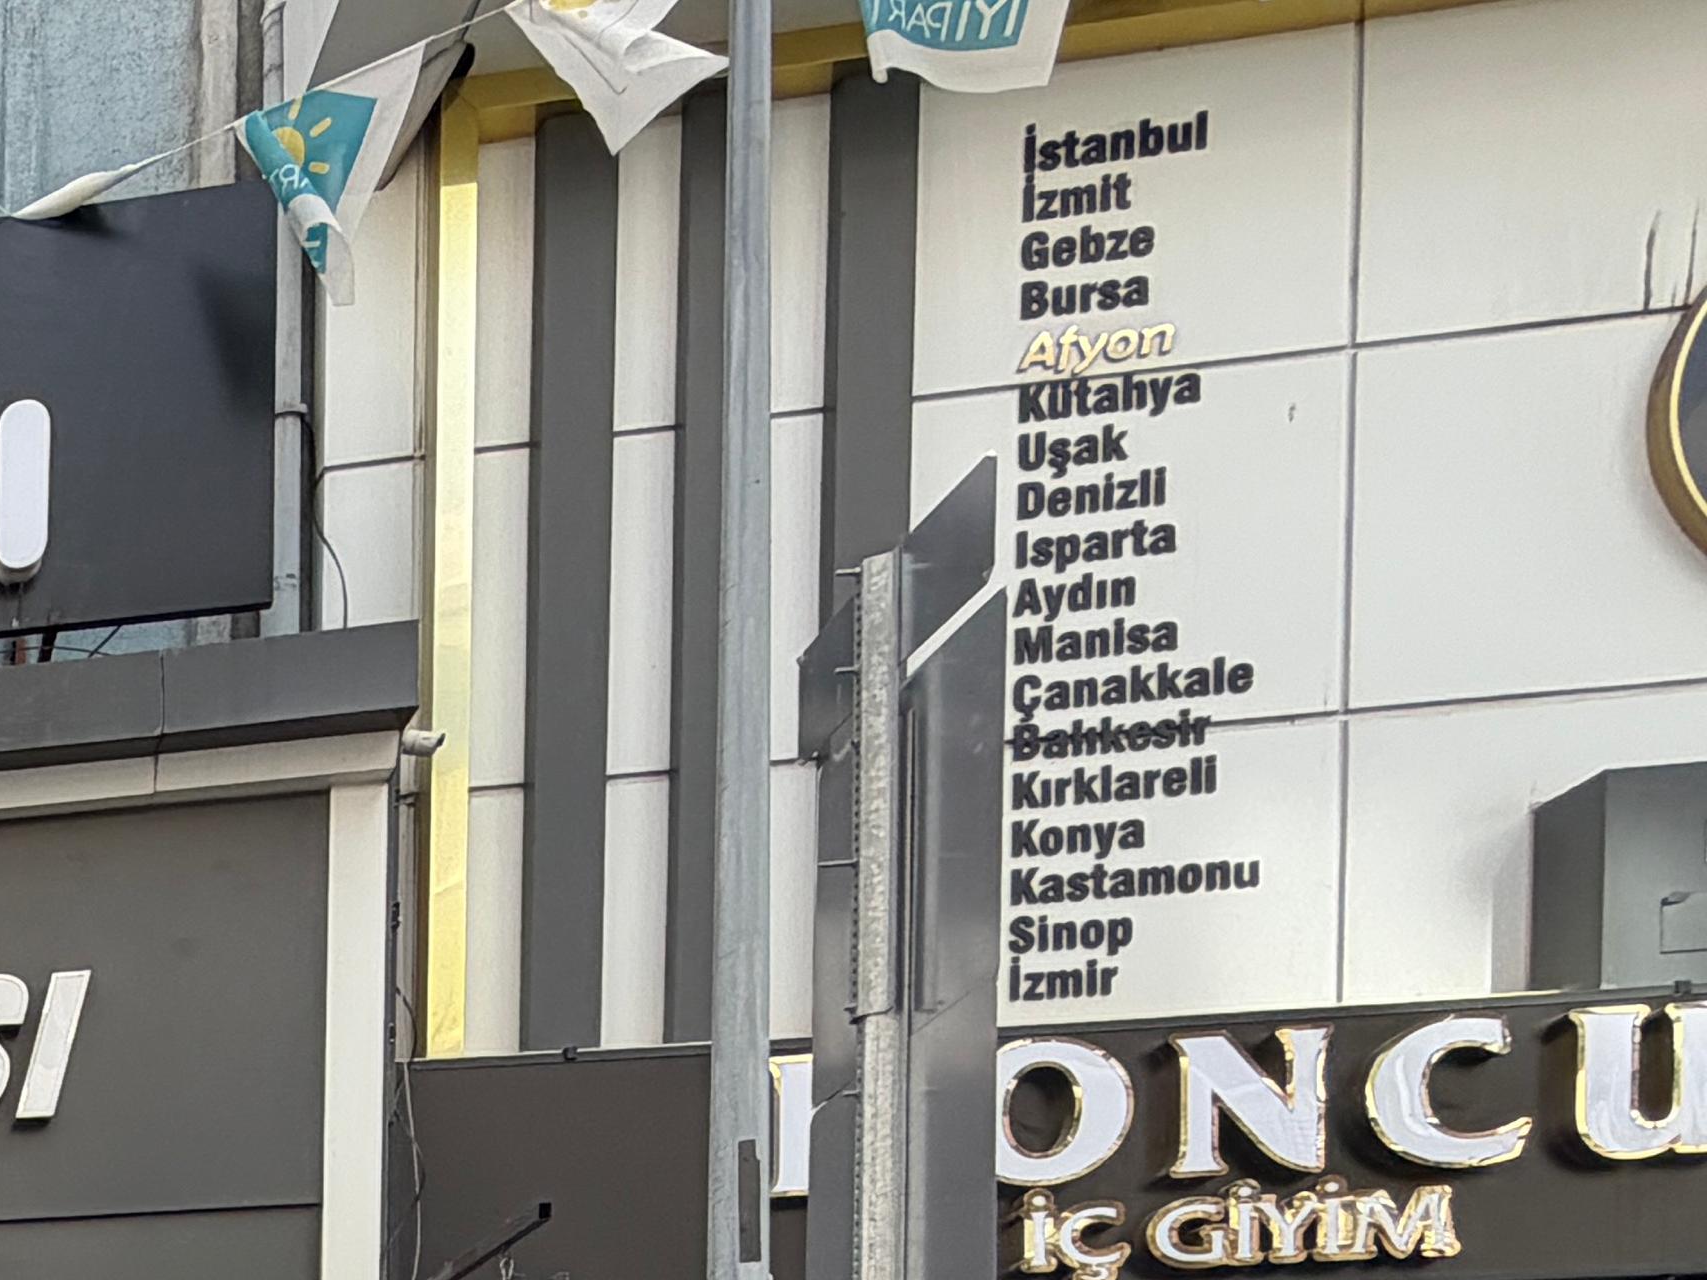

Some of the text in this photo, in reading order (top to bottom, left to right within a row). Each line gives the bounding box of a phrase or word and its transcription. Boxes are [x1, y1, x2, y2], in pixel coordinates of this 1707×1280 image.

[1023, 109, 1210, 173] İstanbul
[1022, 172, 1132, 223] İzmit
[1021, 224, 1156, 271] Gebze
[1020, 276, 1150, 320] Bursa
[1017, 322, 1176, 379] Afyon
[1018, 370, 1202, 424] Kütahya
[1018, 424, 1129, 479] Uşak
[1017, 467, 1167, 521] Denizli
[1016, 522, 1177, 571] Isparta
[1013, 574, 1137, 621] Aydın
[1014, 617, 1178, 665] Manisa
[1013, 656, 1255, 722] Çanakkale
[1013, 709, 1212, 763] Balıkesir
[1011, 756, 1218, 810] Kırklareli
[1011, 819, 1145, 859] Konya
[1010, 859, 1260, 906] Kastamonu
[1009, 915, 1133, 955] Sinop
[1009, 957, 1119, 1003] İzmir
[768, 1001, 1707, 1196] ONCU
[1148, 1175, 1463, 1269] GİYİM
